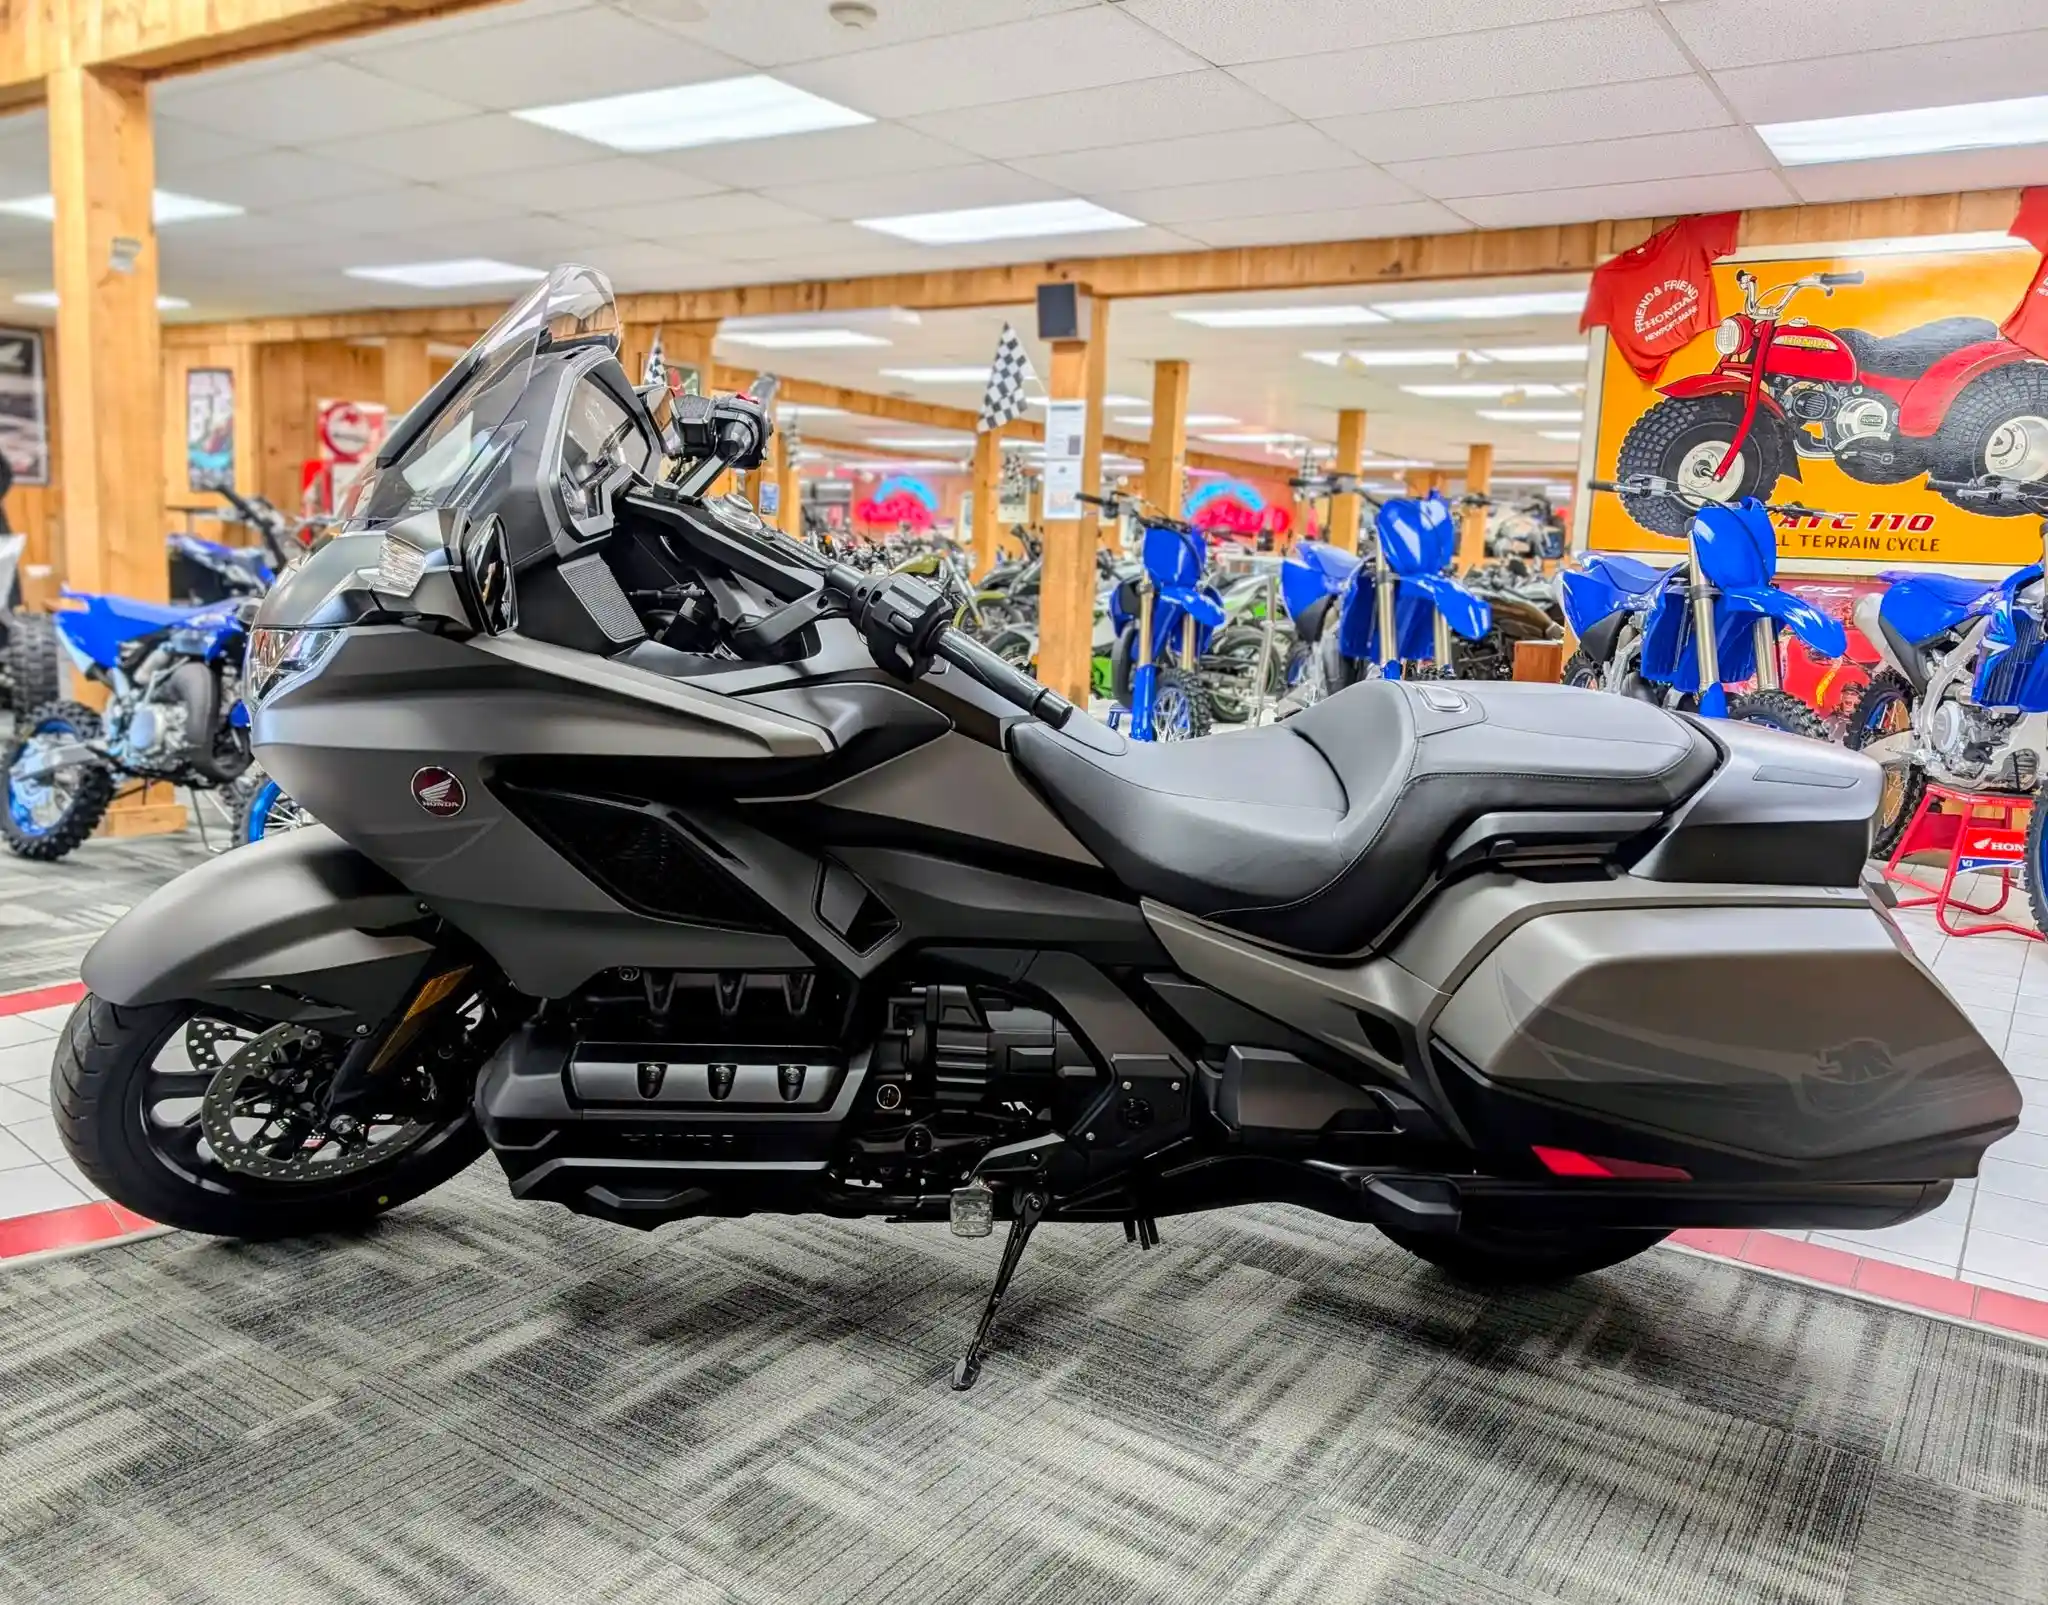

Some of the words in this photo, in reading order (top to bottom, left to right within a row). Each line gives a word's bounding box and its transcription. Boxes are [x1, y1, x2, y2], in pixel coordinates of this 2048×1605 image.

[1634, 292, 1655, 334] FRIEND
[1663, 279, 1699, 301] FRIEND
[1644, 296, 1693, 331] HONDA
[1867, 513, 1936, 532] 110
[1799, 534, 1881, 551] TERRAIN
[1886, 537, 1941, 552] CYCLE
[1991, 842, 2025, 852] HON
